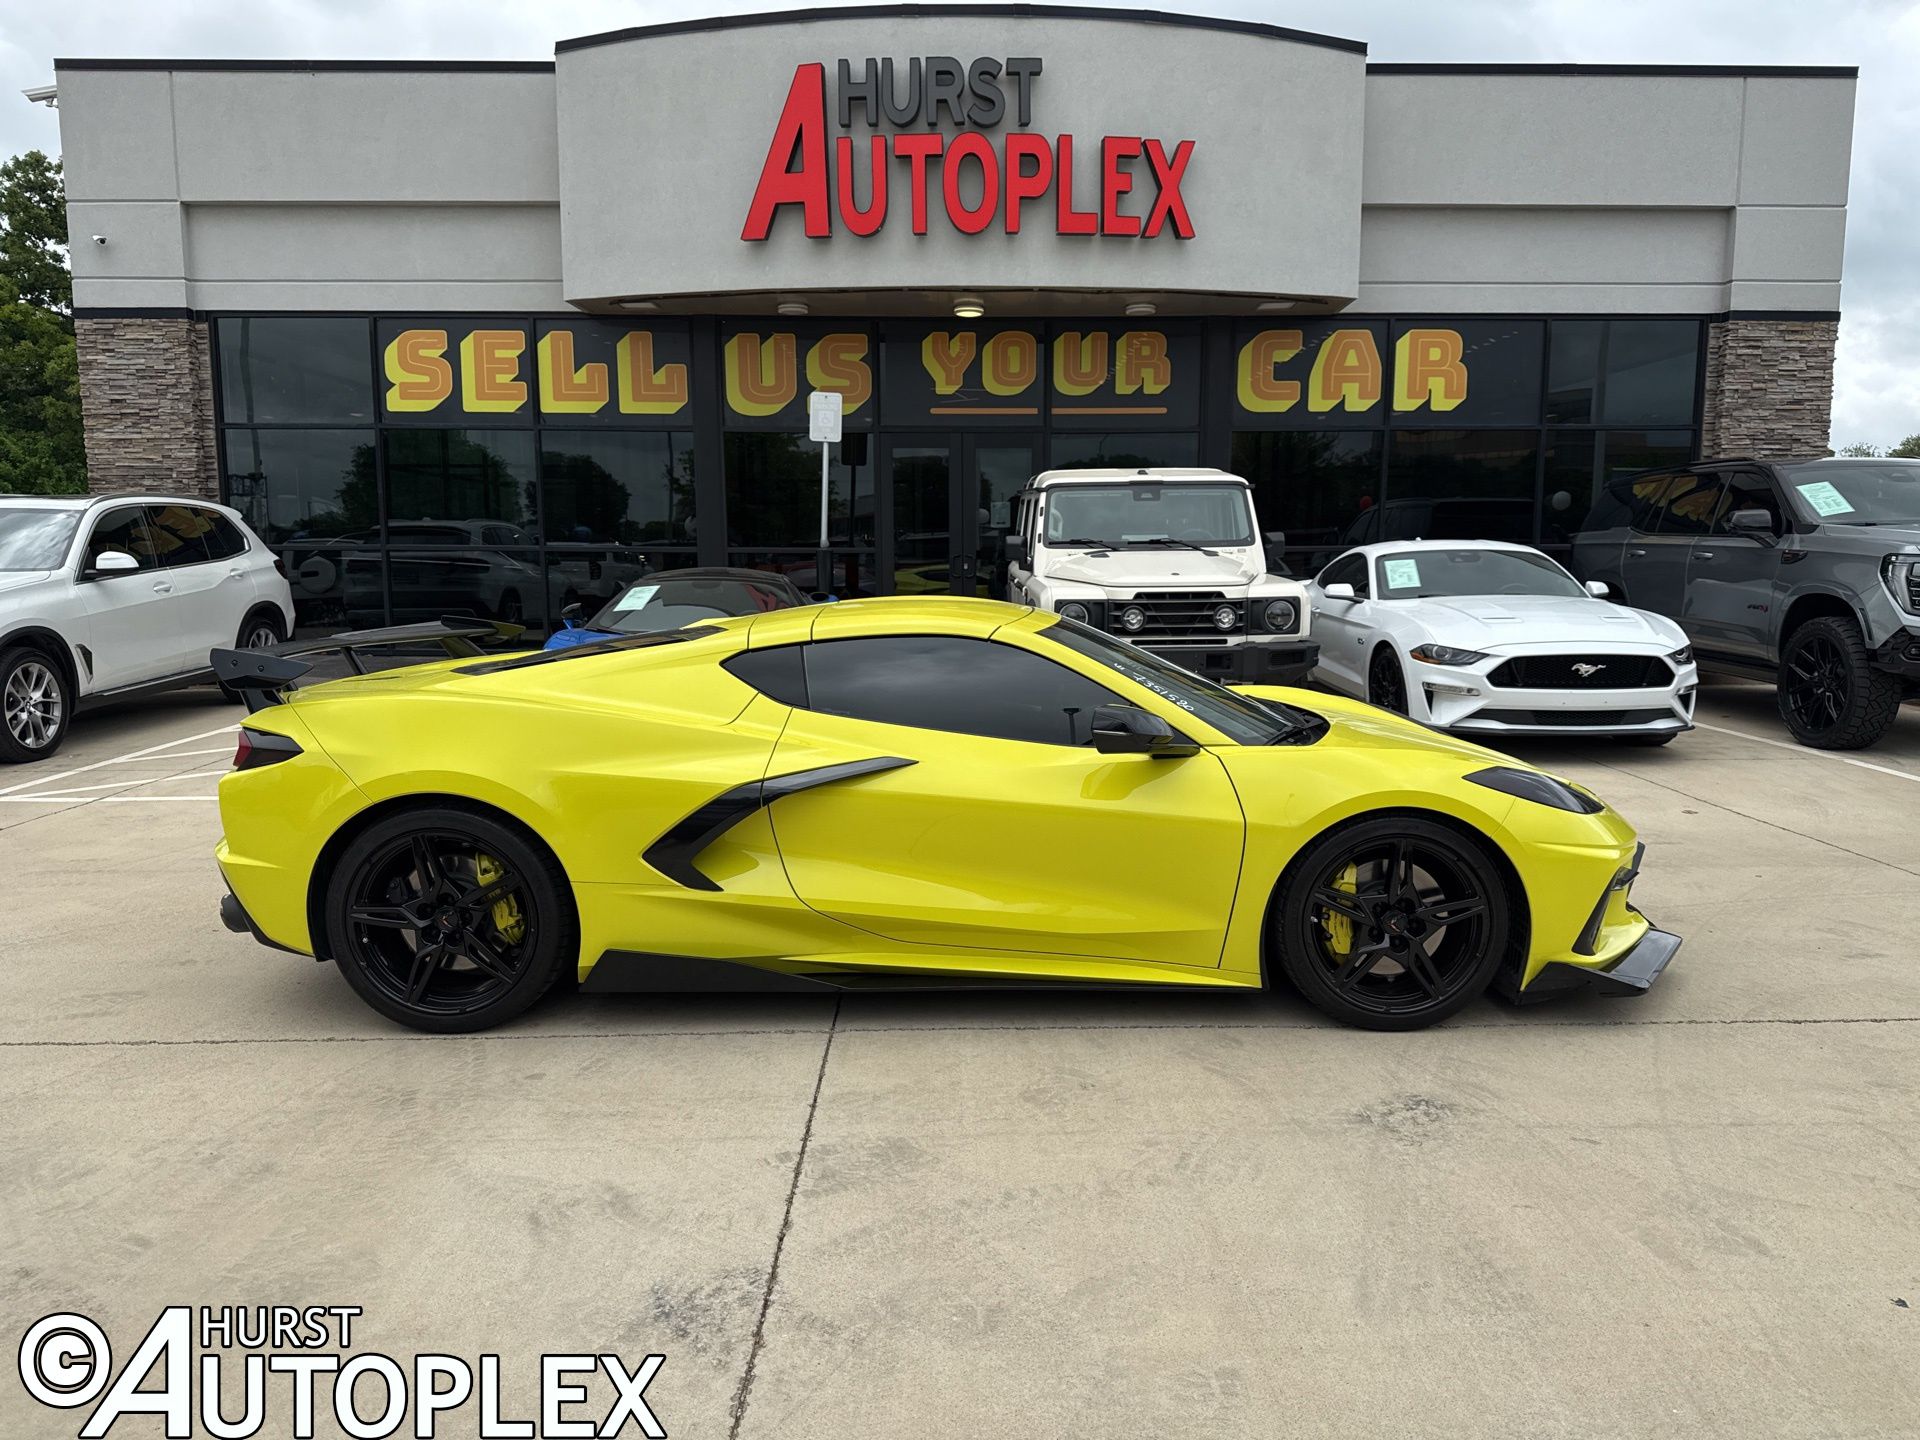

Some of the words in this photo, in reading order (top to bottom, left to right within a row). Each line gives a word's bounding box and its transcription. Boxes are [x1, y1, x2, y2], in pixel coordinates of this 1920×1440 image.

[838, 57, 1043, 128] HURST
[740, 62, 1196, 241] AUTOPLEX
[384, 329, 688, 414] SELL
[725, 332, 873, 417] US
[922, 330, 1171, 396] YOUR
[1237, 329, 1468, 413] CAR
